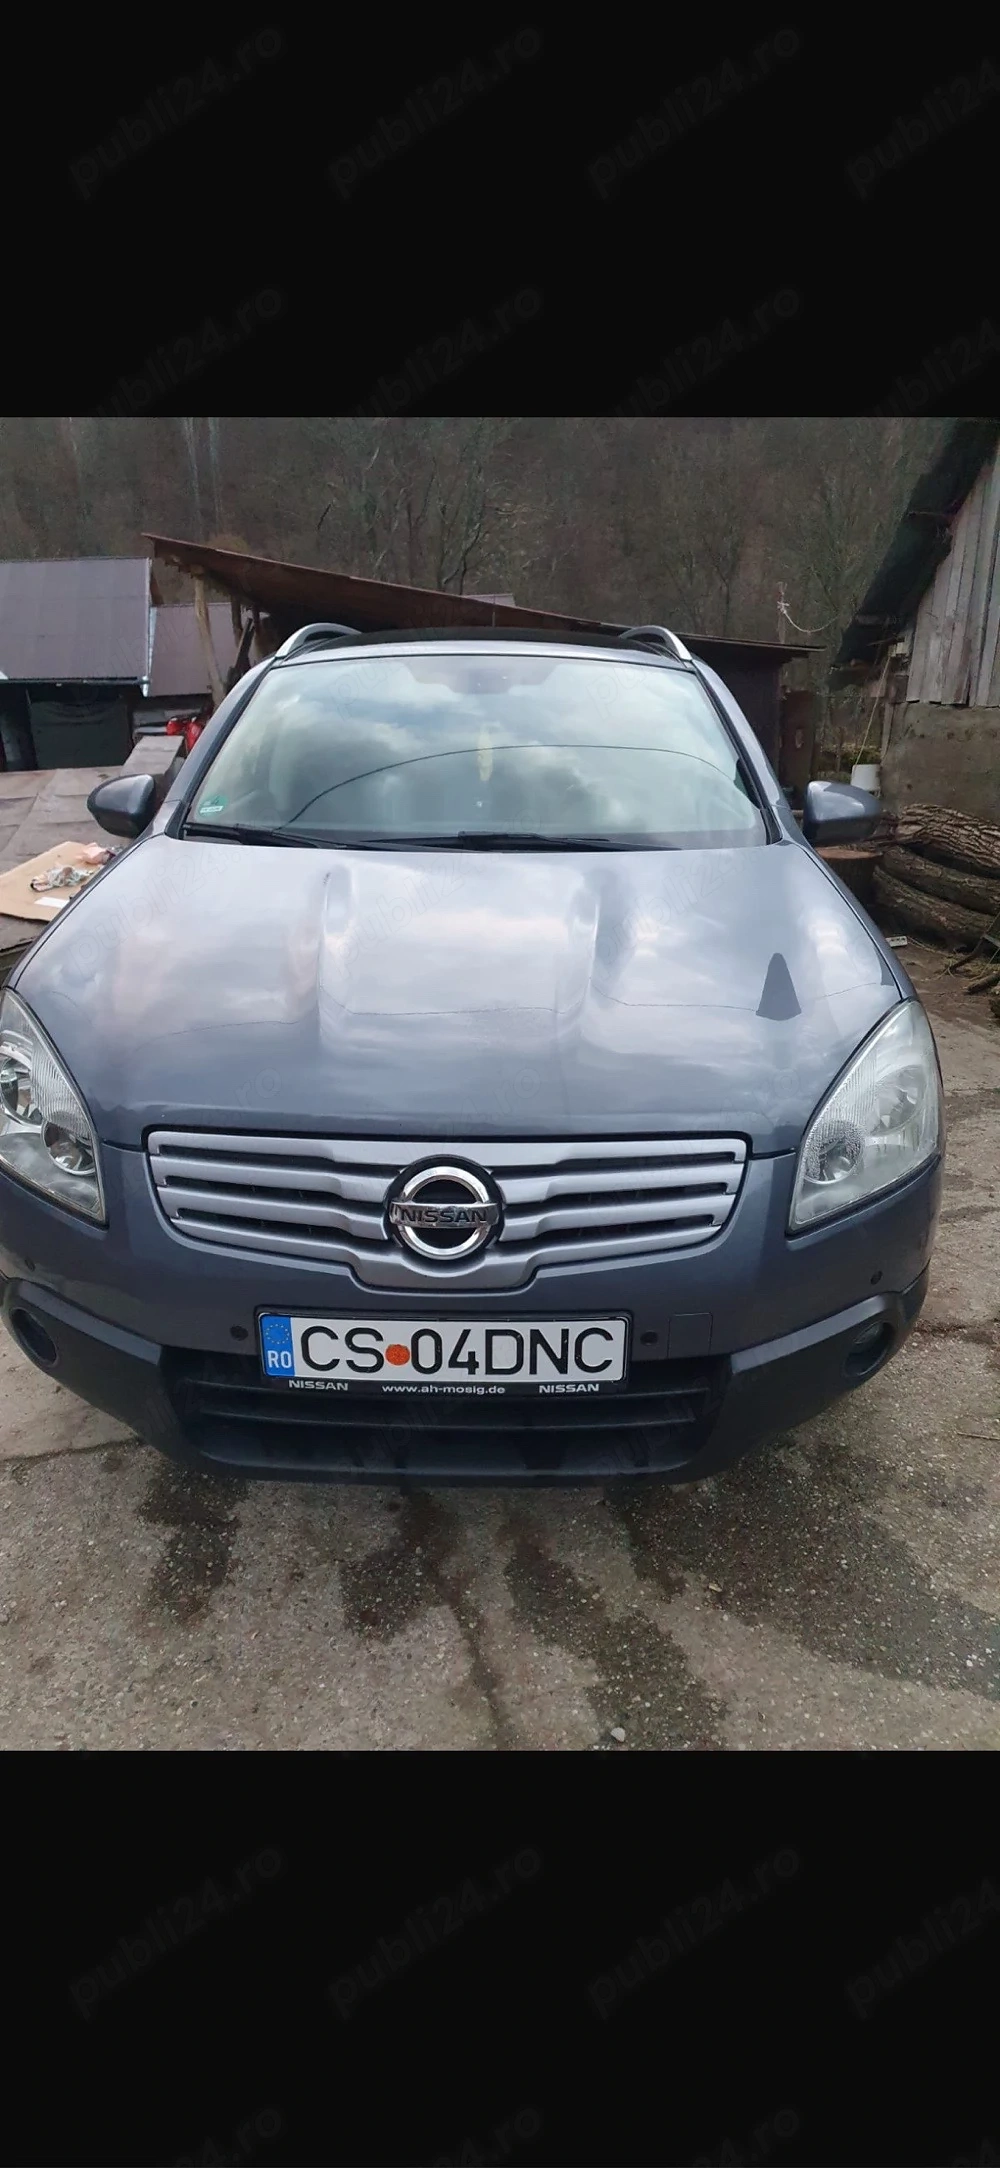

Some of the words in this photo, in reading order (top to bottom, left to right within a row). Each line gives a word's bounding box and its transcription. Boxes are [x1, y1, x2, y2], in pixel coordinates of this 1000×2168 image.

[400, 1209, 487, 1223] NISSAN
[301, 1326, 384, 1374] CS
[411, 1328, 613, 1375] 04DNC
[267, 1350, 292, 1369] RO
[288, 1379, 349, 1391] NISSAN
[382, 1384, 506, 1395] www.ah-mosig.de
[539, 1383, 600, 1394] NISSAN
